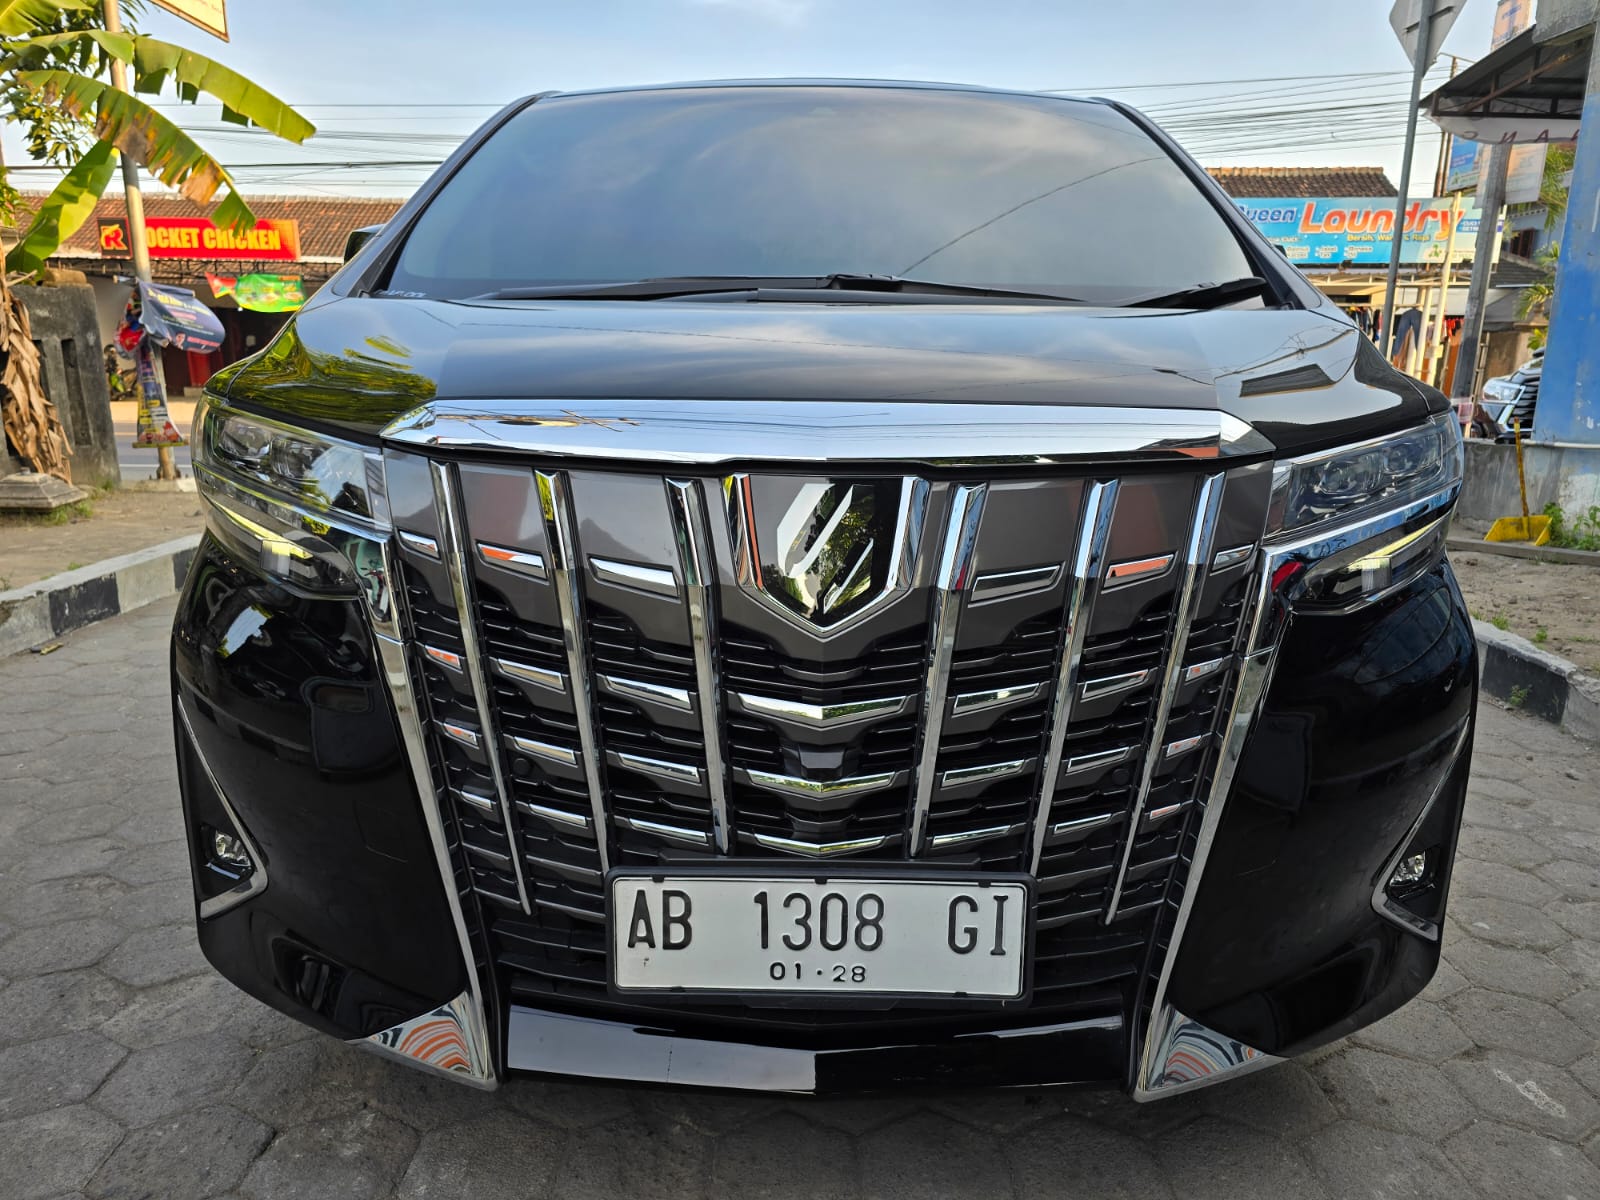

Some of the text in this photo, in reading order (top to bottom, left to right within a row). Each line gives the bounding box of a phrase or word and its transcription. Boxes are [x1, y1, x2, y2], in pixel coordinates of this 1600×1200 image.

[146, 227, 281, 250] OCKET CHICKEN
[1239, 201, 1466, 241] ueen Laundry
[628, 890, 1009, 956] AB 1308 GI
